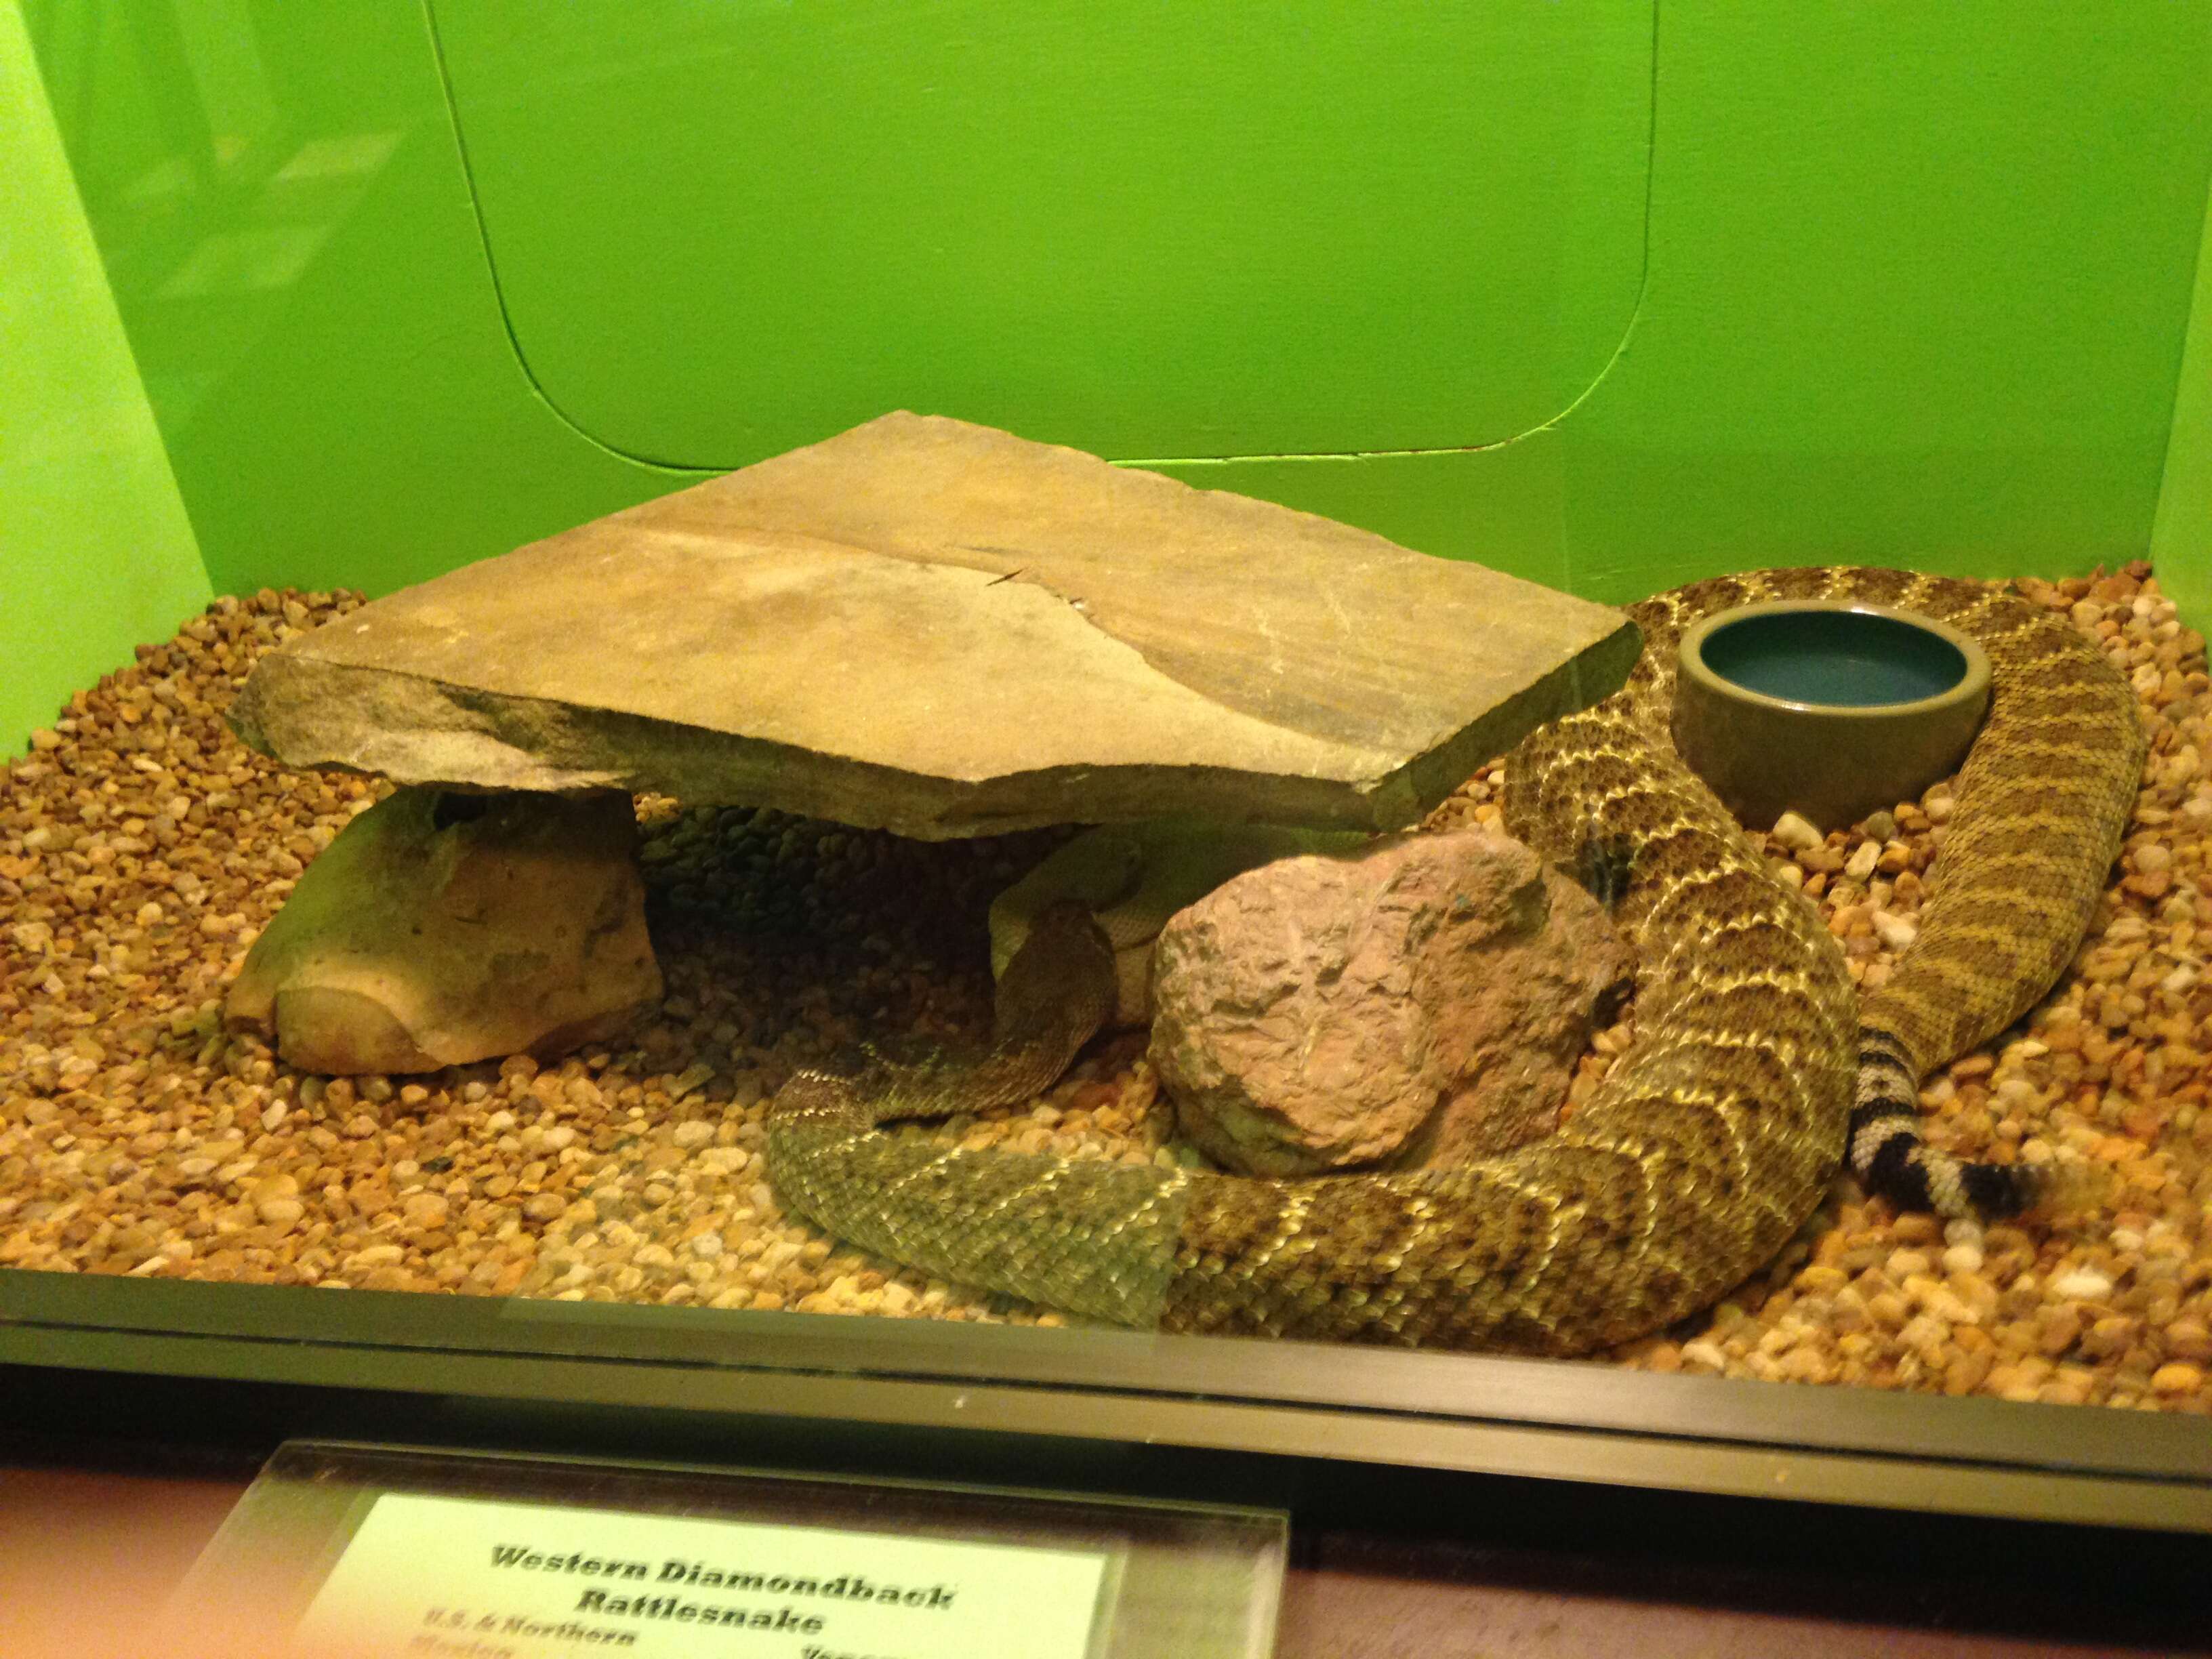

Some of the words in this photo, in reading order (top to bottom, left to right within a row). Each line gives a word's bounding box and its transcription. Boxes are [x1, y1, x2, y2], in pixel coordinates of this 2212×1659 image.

[491, 1544, 647, 1580] Western
[655, 1558, 954, 1610] Diamondback
[501, 1616, 637, 1646] Northern
[574, 1589, 823, 1634] Rattlesnake
